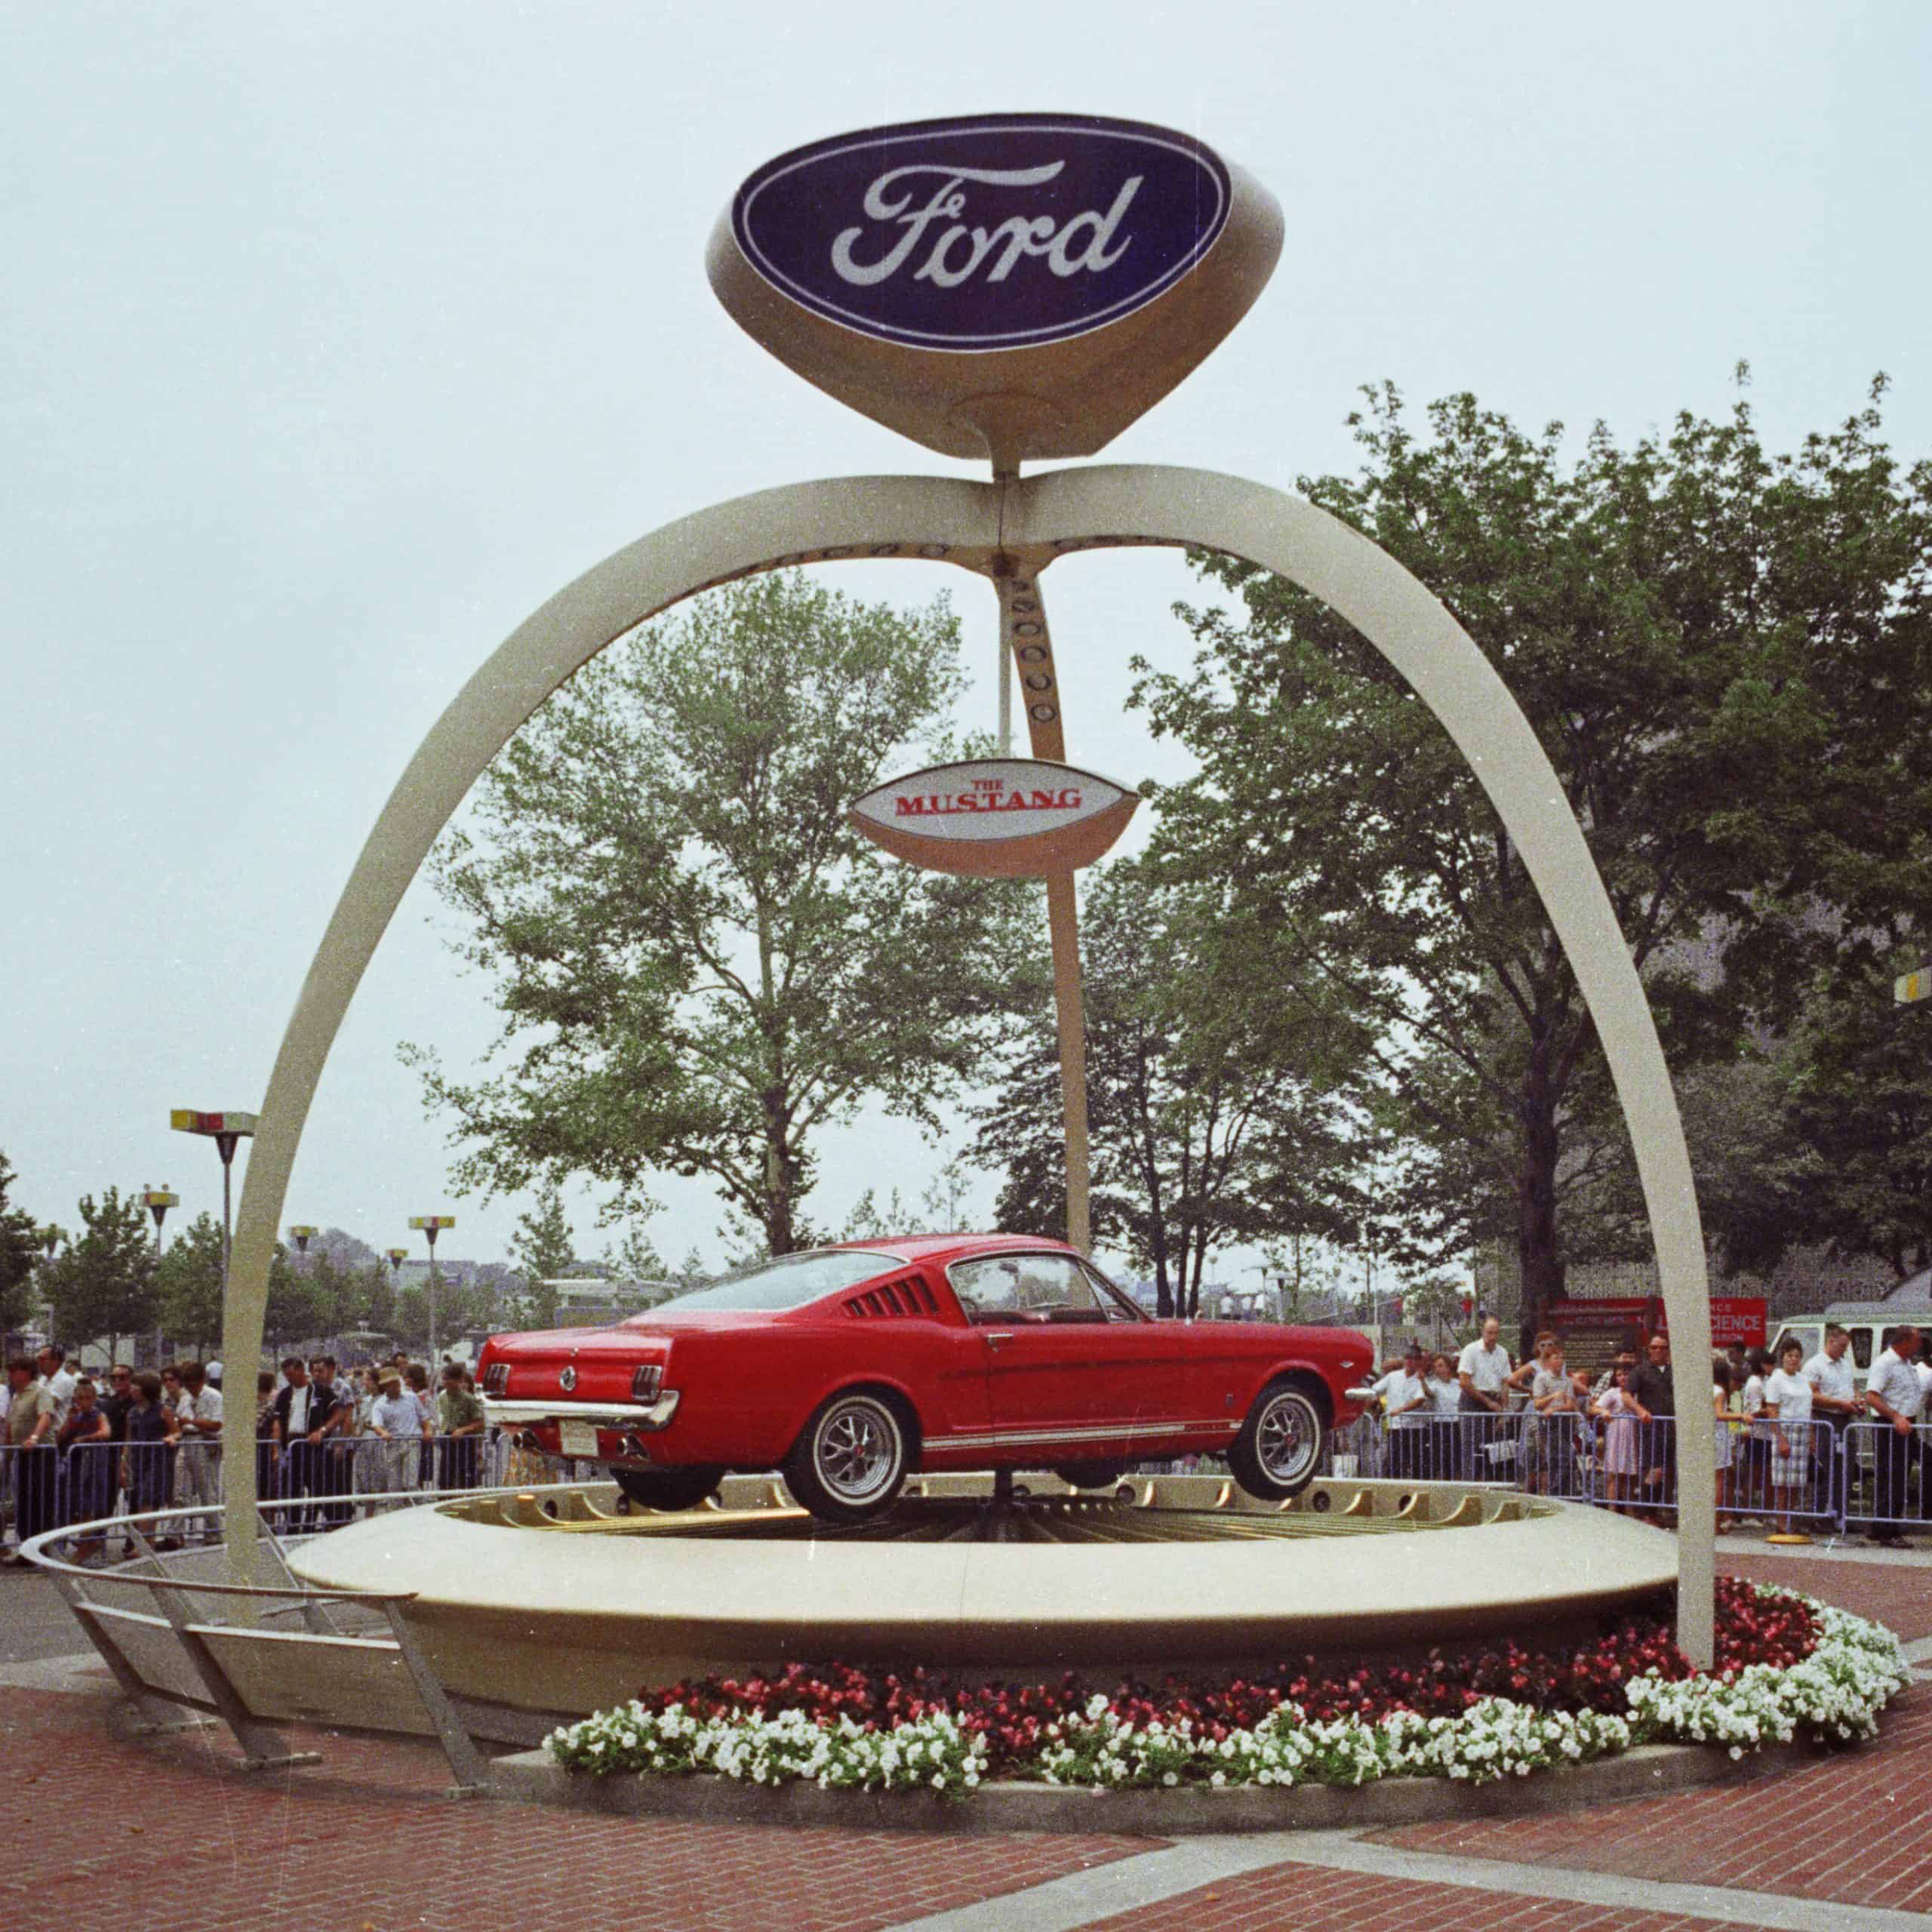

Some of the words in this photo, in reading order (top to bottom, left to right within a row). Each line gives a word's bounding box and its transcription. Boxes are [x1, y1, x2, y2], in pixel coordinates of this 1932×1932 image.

[830, 159, 1146, 289] Ford
[971, 779, 1004, 791] THE
[894, 788, 1084, 816] MUSTANG
[1711, 1315, 1761, 1331] CIENCE
